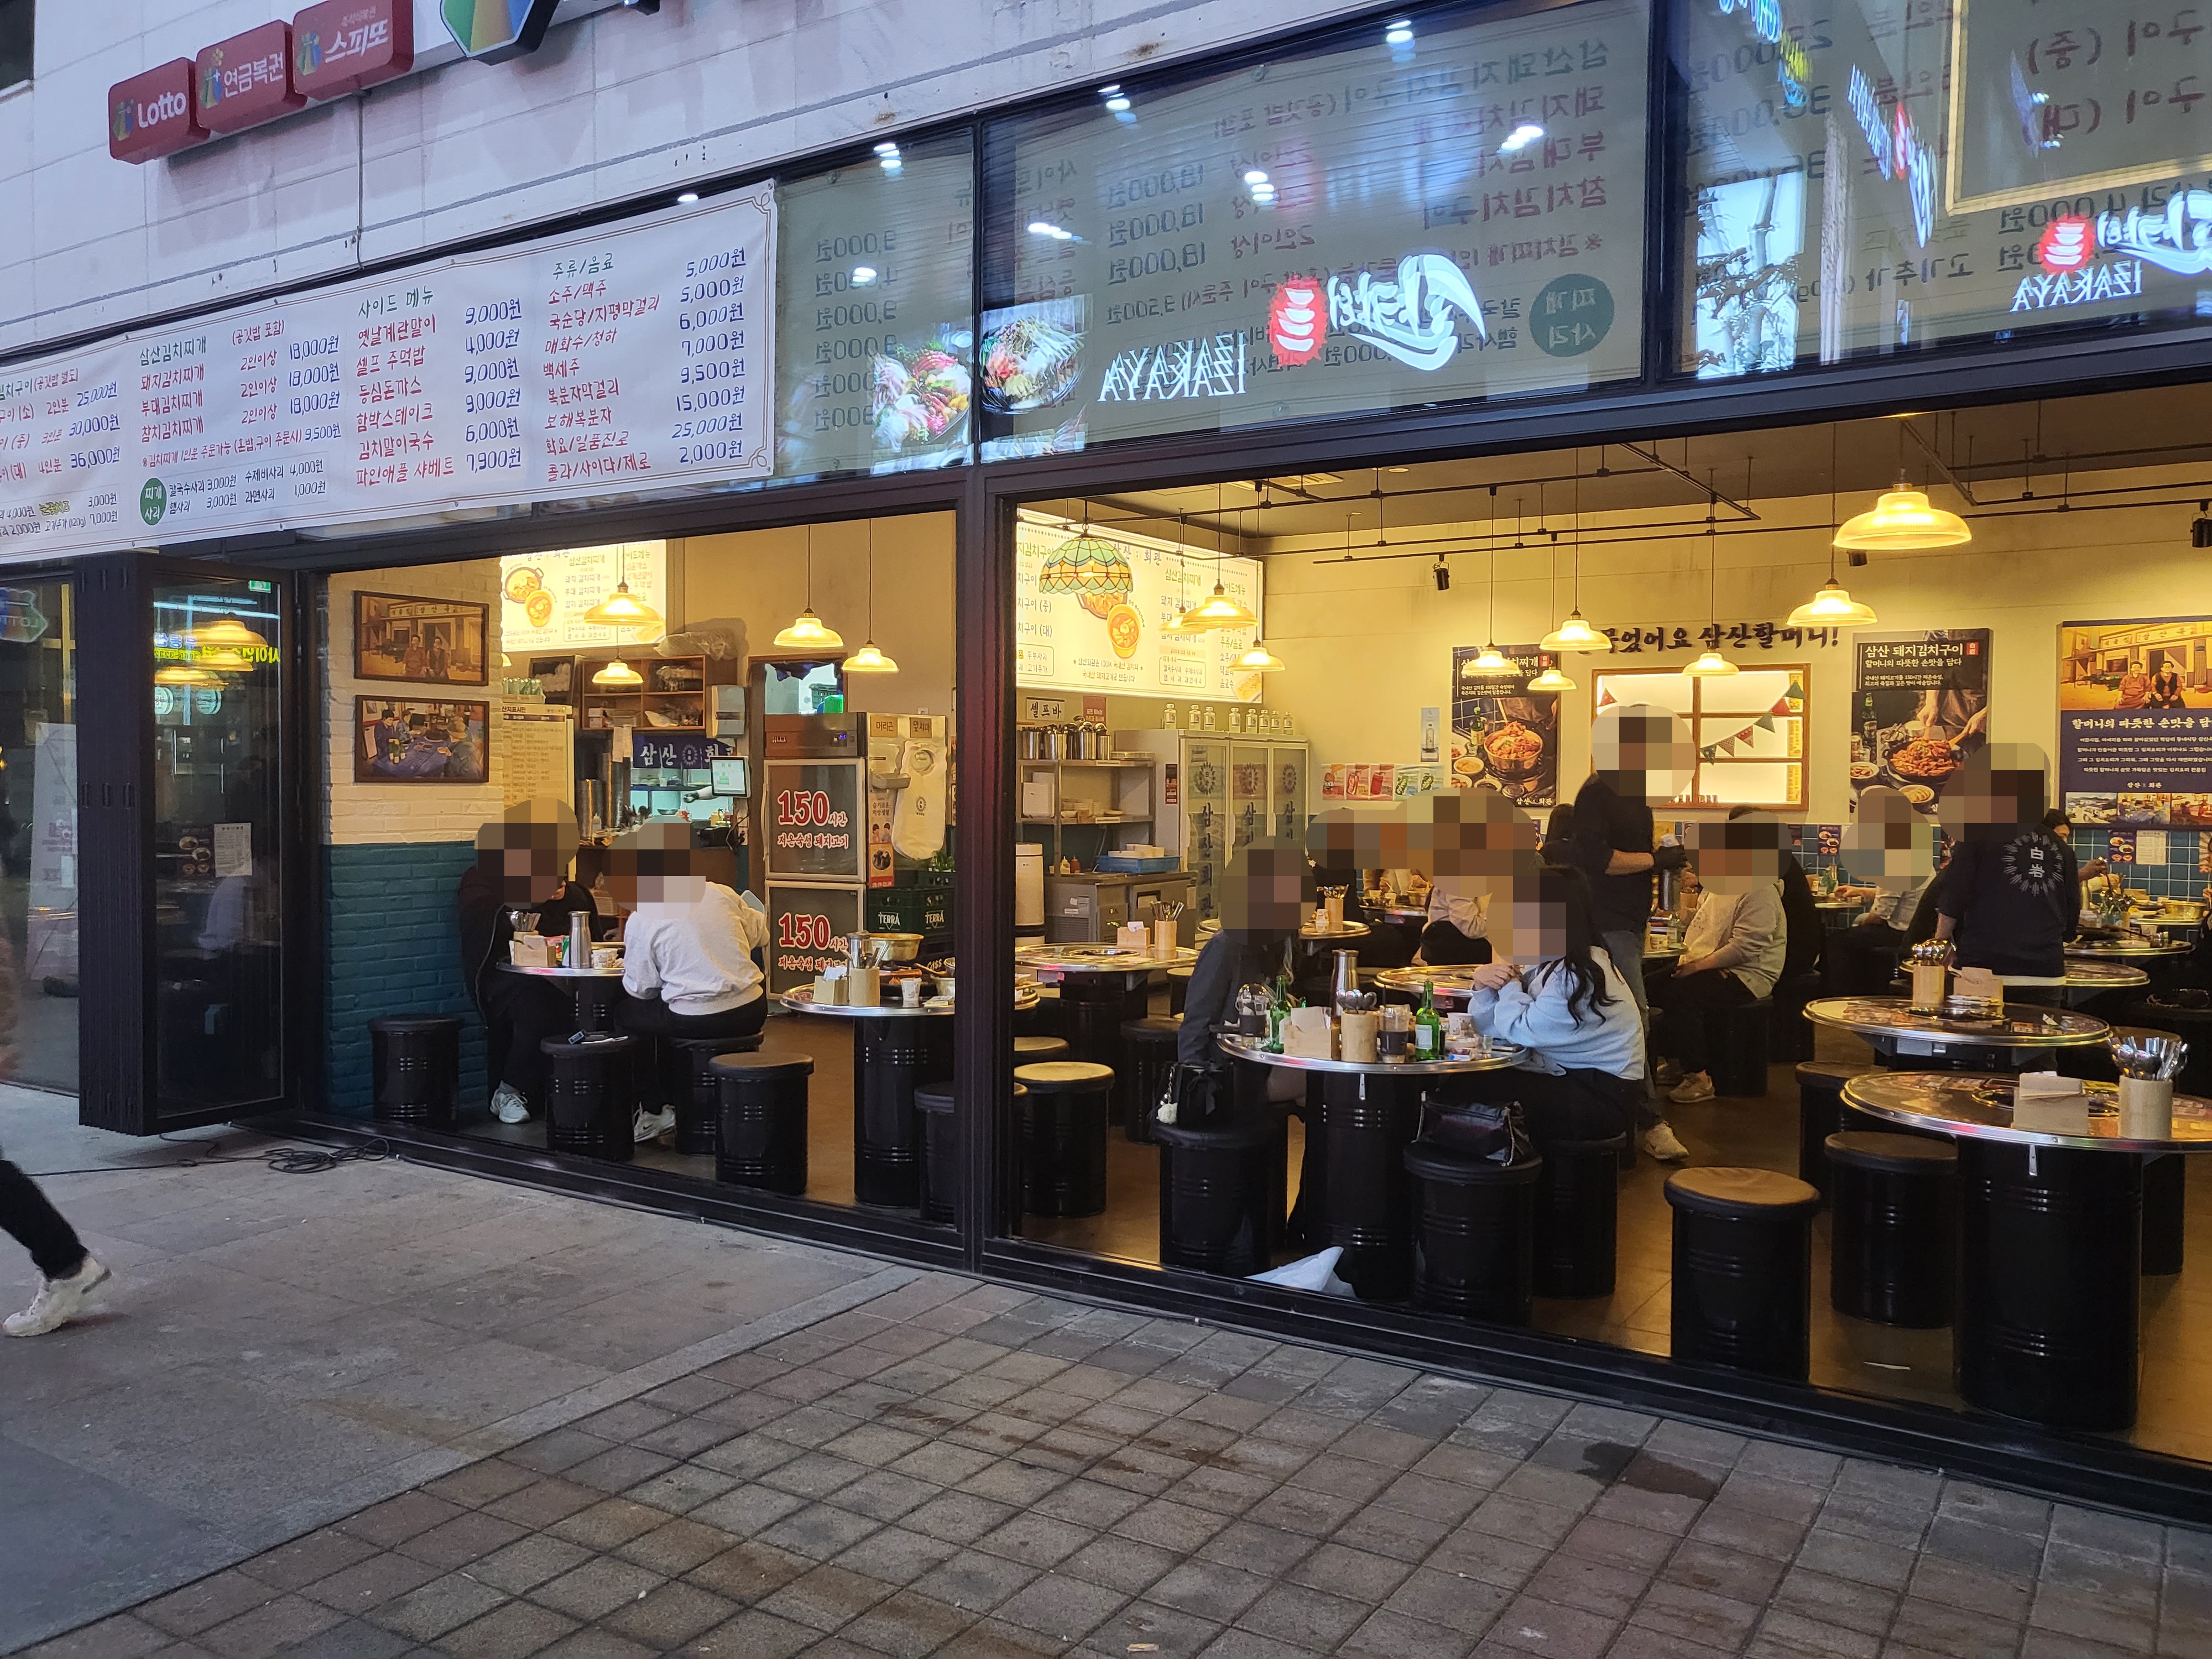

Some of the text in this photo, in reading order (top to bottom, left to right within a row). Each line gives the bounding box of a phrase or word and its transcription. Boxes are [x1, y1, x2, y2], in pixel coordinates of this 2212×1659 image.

[325, 20, 389, 64] 스피또
[223, 51, 284, 98] 연금복권
[137, 92, 187, 129] Lotto
[548, 246, 747, 305] 소주/맥주 5,000원
[552, 252, 614, 281] 주류/음료
[358, 285, 434, 319] 사이드 메뉴
[549, 274, 745, 331] 국순당/지평막걸리 5,000원
[357, 296, 523, 349] 옛날계란말이 9,000원
[544, 301, 745, 356] 매화수/청하 6,000원
[139, 319, 284, 367] 삼산김치찌개 (공깃밥 포함)
[140, 334, 340, 391] 돼지김치찌개 2인이상 18,000원
[356, 327, 520, 378] 셀프 주먹밥 4,000원
[542, 329, 746, 380] 백세주 7,000원
[140, 361, 340, 417] 부대김치찌개 2인이상 18,000원
[358, 356, 520, 405] 등심돈까스 9,000원
[548, 357, 746, 406] 복분자막걸리 9,500원
[19, 380, 118, 422] (소) 2인분 25,000원
[141, 389, 341, 443] 참치김치찌개 2인이상 18,000원
[356, 387, 521, 434] 함박스테이크 9,000원
[544, 385, 745, 430] 보해복분자 15,000원
[69, 413, 121, 437] 30,000원
[181, 447, 198, 462] 1인분
[200, 441, 232, 459] 주문가능
[275, 429, 302, 447] 주문시)
[305, 422, 341, 442] 9,500원
[358, 415, 520, 461] 김치말이국수 6,000원
[546, 411, 744, 456] 화요/일품진로 25,000원
[38, 458, 62, 474] 4인분
[70, 446, 120, 469] 36,000원
[168, 458, 324, 497] 칼국수사리 3,000원 수제비사리 4,000원
[356, 446, 521, 487] 파인애플 샤베트 7,900원
[547, 439, 744, 482] 콜라/사이다/제로 2,000원
[6, 504, 36, 520] 4,000원
[88, 492, 117, 508] 3,000원
[144, 484, 163, 500] 찌개
[169, 479, 326, 515] 햄사리 3,000원 라면사리 1,000원
[11, 521, 40, 536] 2,000원
[89, 509, 118, 525] 7,000원
[144, 505, 161, 520] 사리
[1698, 622, 1839, 651] 삼산할머니!
[1865, 643, 1963, 658] 삼산 돼지김치구이
[1865, 657, 1963, 668] 할머니의 따뜻한 손맛을 담다
[875, 721, 894, 732] 머리끈
[913, 721, 930, 733] 앞치마
[1030, 701, 1062, 719] 셀프바
[2072, 717, 2195, 730] 할머니의 따뜻한 손맛을
[640, 743, 677, 766] 삼산
[778, 833, 849, 850] 저온숙성 돼지고기
[878, 912, 900, 926] TERRA
[925, 911, 945, 924] TERRA
[779, 955, 813, 971] 저온숙성
